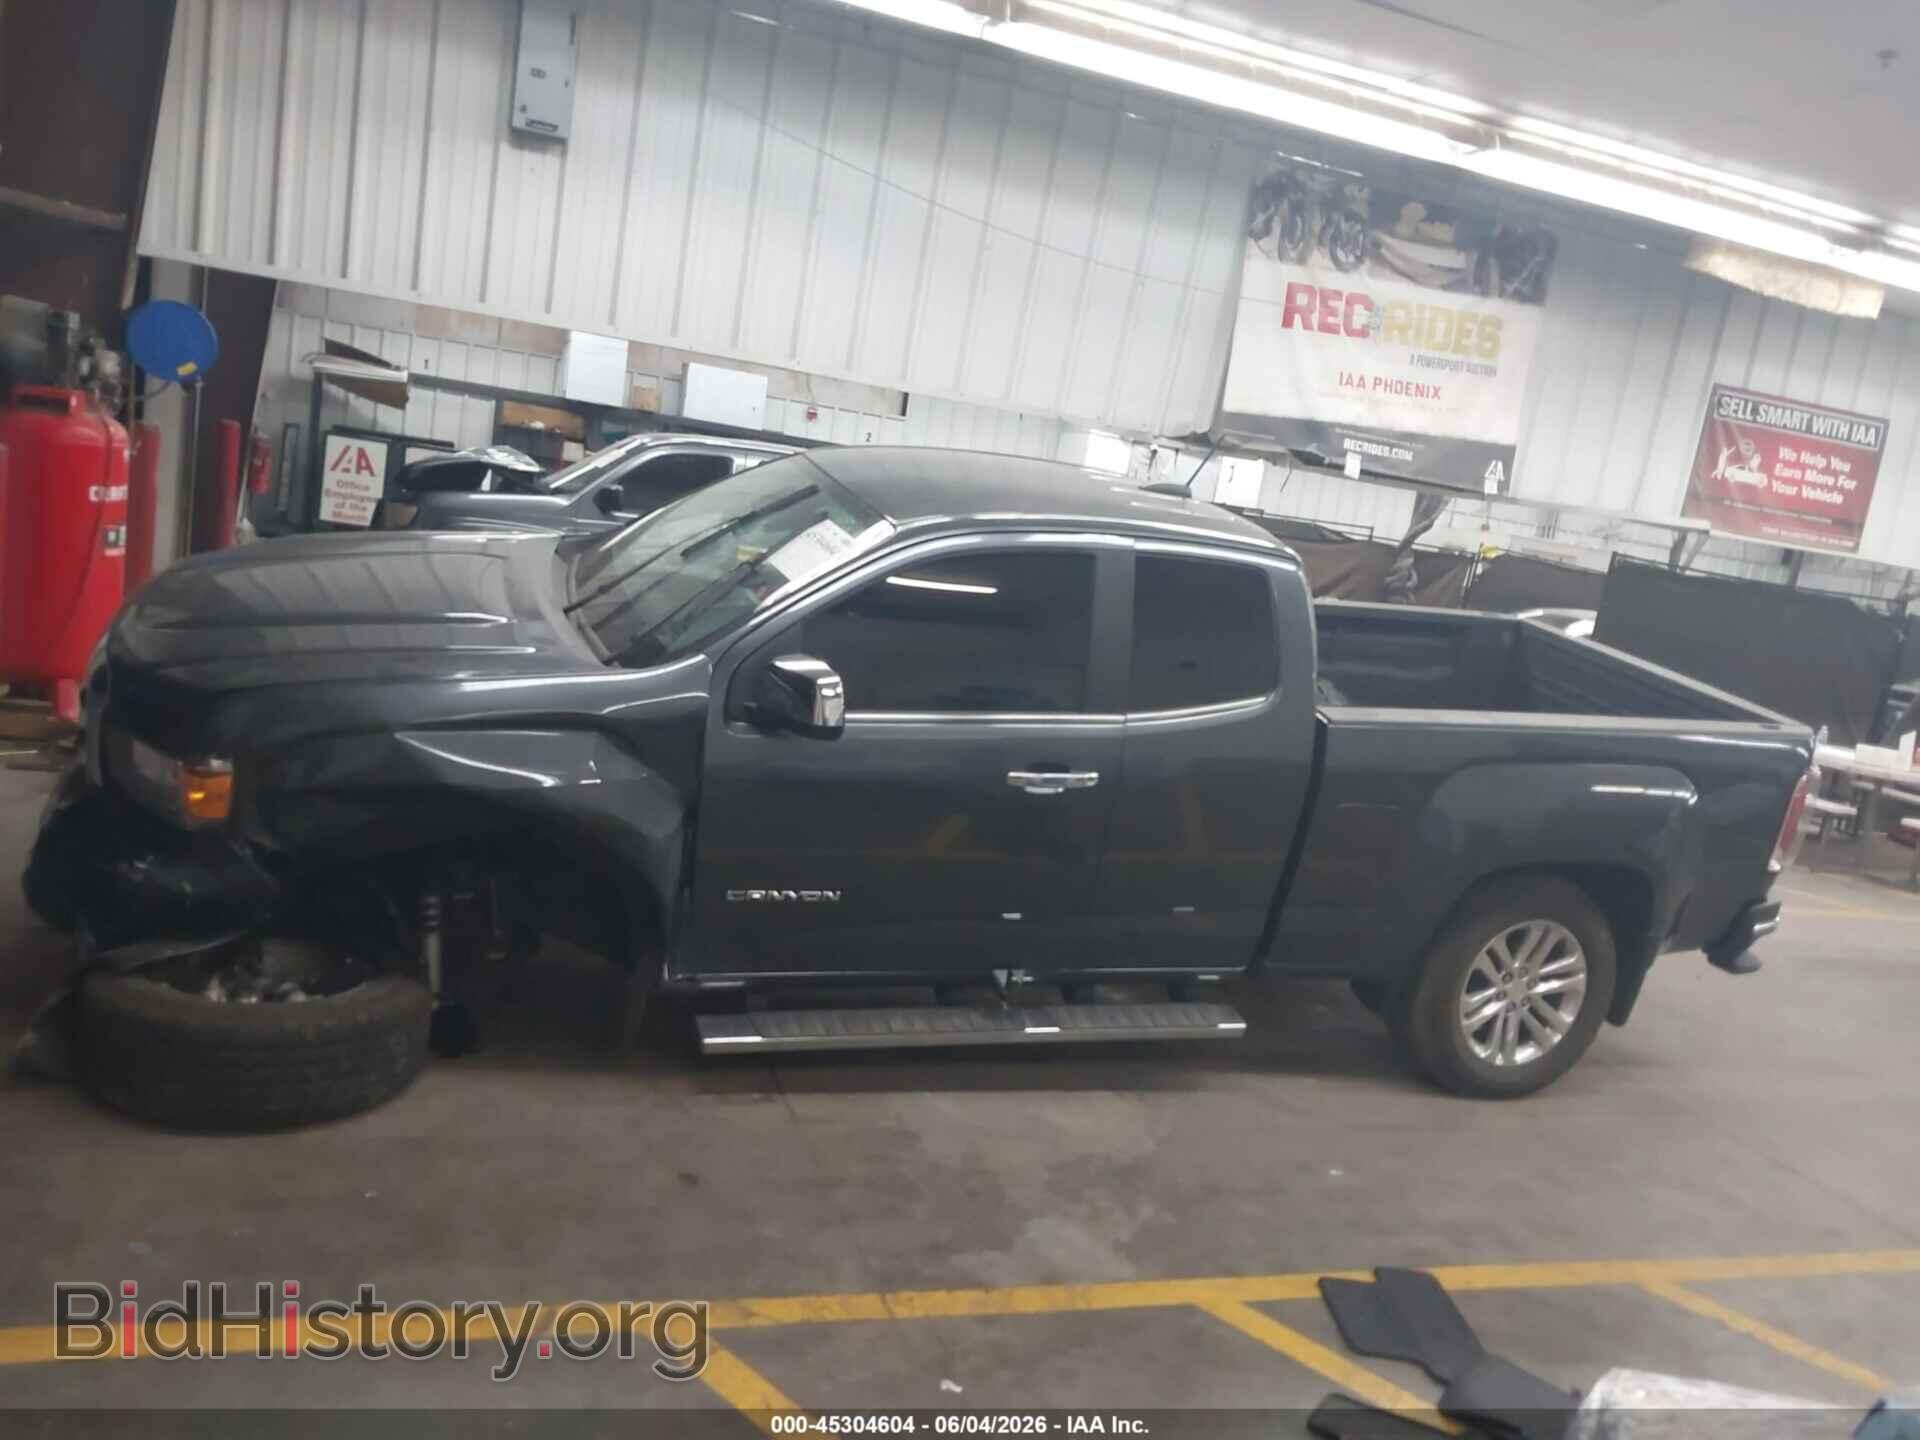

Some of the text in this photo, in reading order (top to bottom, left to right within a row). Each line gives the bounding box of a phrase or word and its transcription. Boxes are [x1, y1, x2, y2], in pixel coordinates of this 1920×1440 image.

[1280, 281, 1374, 339] REC
[1382, 299, 1502, 360] RIDES
[1338, 371, 1442, 400] IAA PHOENIX
[1718, 396, 1877, 446] SELL SMART WITH IAA
[1799, 447, 1827, 469] Help
[1830, 453, 1852, 473] You
[1772, 478, 1845, 505] Your Vehicle
[1804, 466, 1835, 487] More
[1837, 472, 1857, 491] For
[726, 890, 842, 901] CANYON
